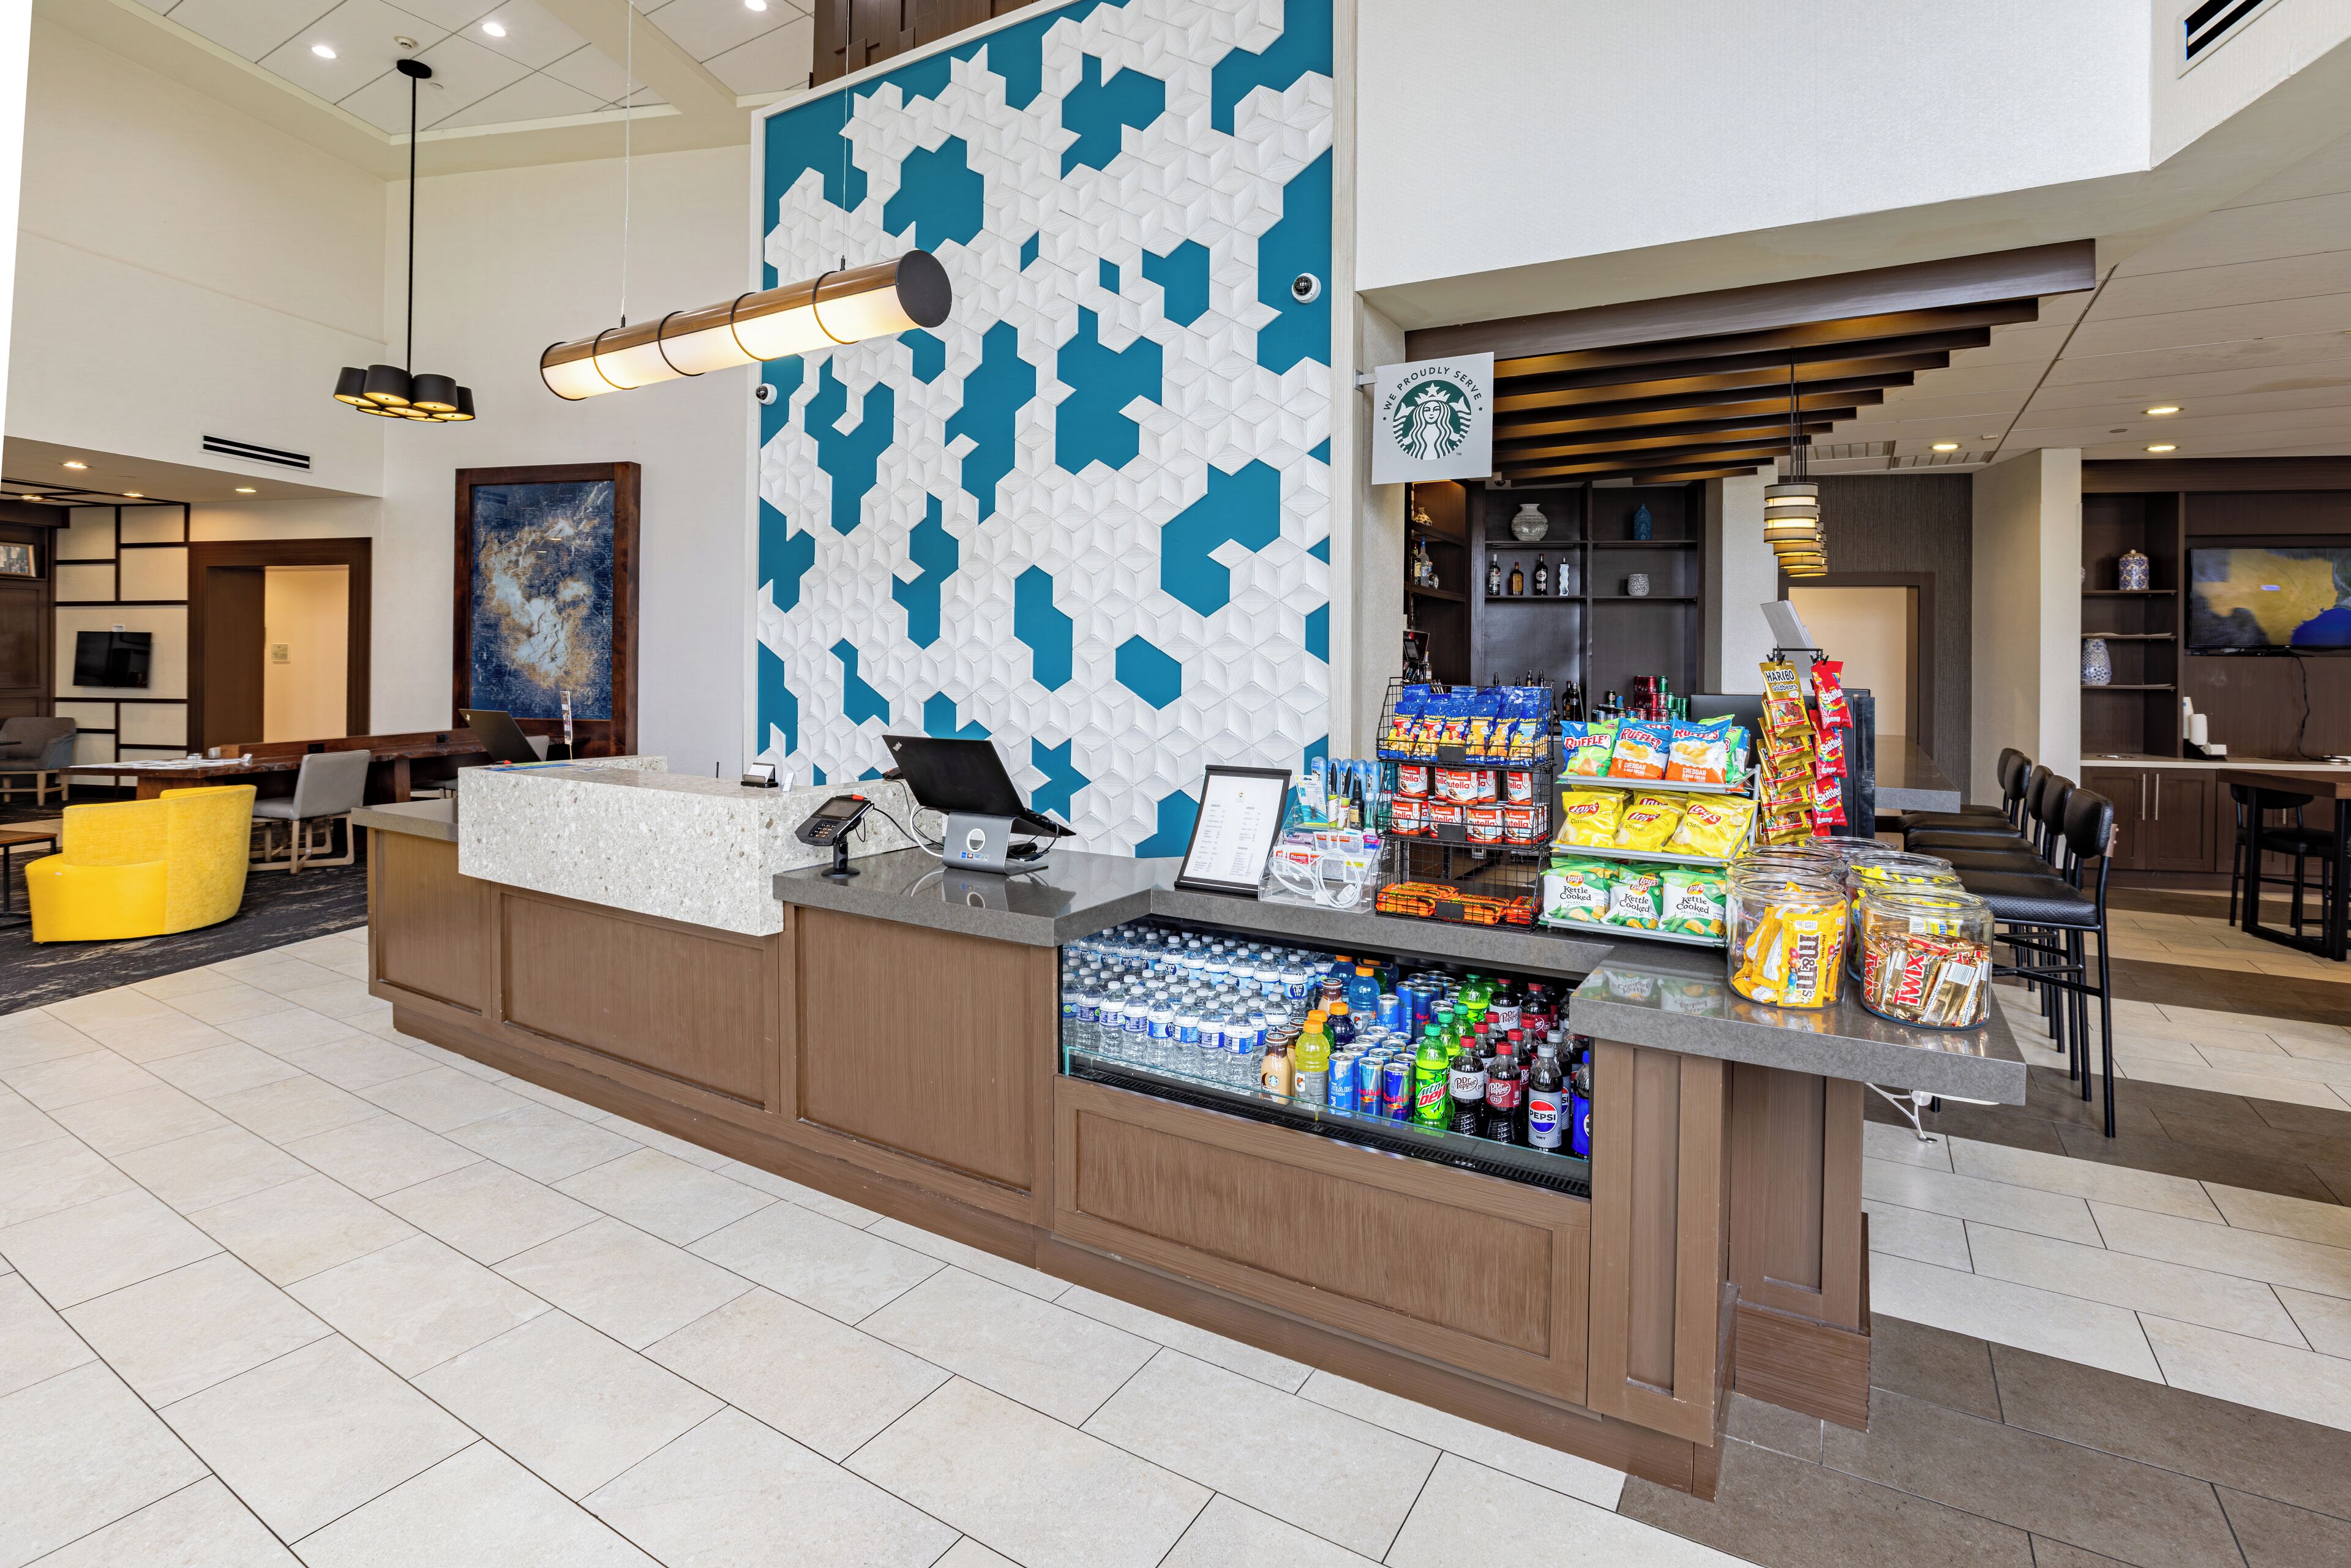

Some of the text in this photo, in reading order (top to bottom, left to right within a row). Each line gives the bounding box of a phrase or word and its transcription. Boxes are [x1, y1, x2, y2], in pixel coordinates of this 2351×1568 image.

[1384, 366, 1482, 410] WE PROUDLY SERVE
[1765, 670, 1795, 682] HARIBO
[1621, 729, 1662, 749] RUFFLES
[1820, 738, 1842, 755] Skittles
[1624, 762, 1646, 770] CHEDDAR
[1815, 787, 1842, 805] Skittles
[1569, 801, 1599, 814] Lay's
[1689, 805, 1720, 822] Lay's
[1630, 812, 1659, 822] Lay's
[1625, 824, 1646, 833] Classic
[1567, 875, 1583, 883] Lay's
[1640, 877, 1657, 886] Lay's
[1624, 893, 1649, 904] Kettle
[1619, 899, 1650, 912] Cooked
[1676, 903, 1709, 914] Cooked
[1500, 1011, 1518, 1022] Pepper
[1455, 1078, 1477, 1090] Pepper
[1489, 1082, 1509, 1095] Pepper
[1368, 1088, 1381, 1097] Bull
[1397, 1094, 1409, 1103] Bull
[1530, 1109, 1556, 1121] PEPSI
